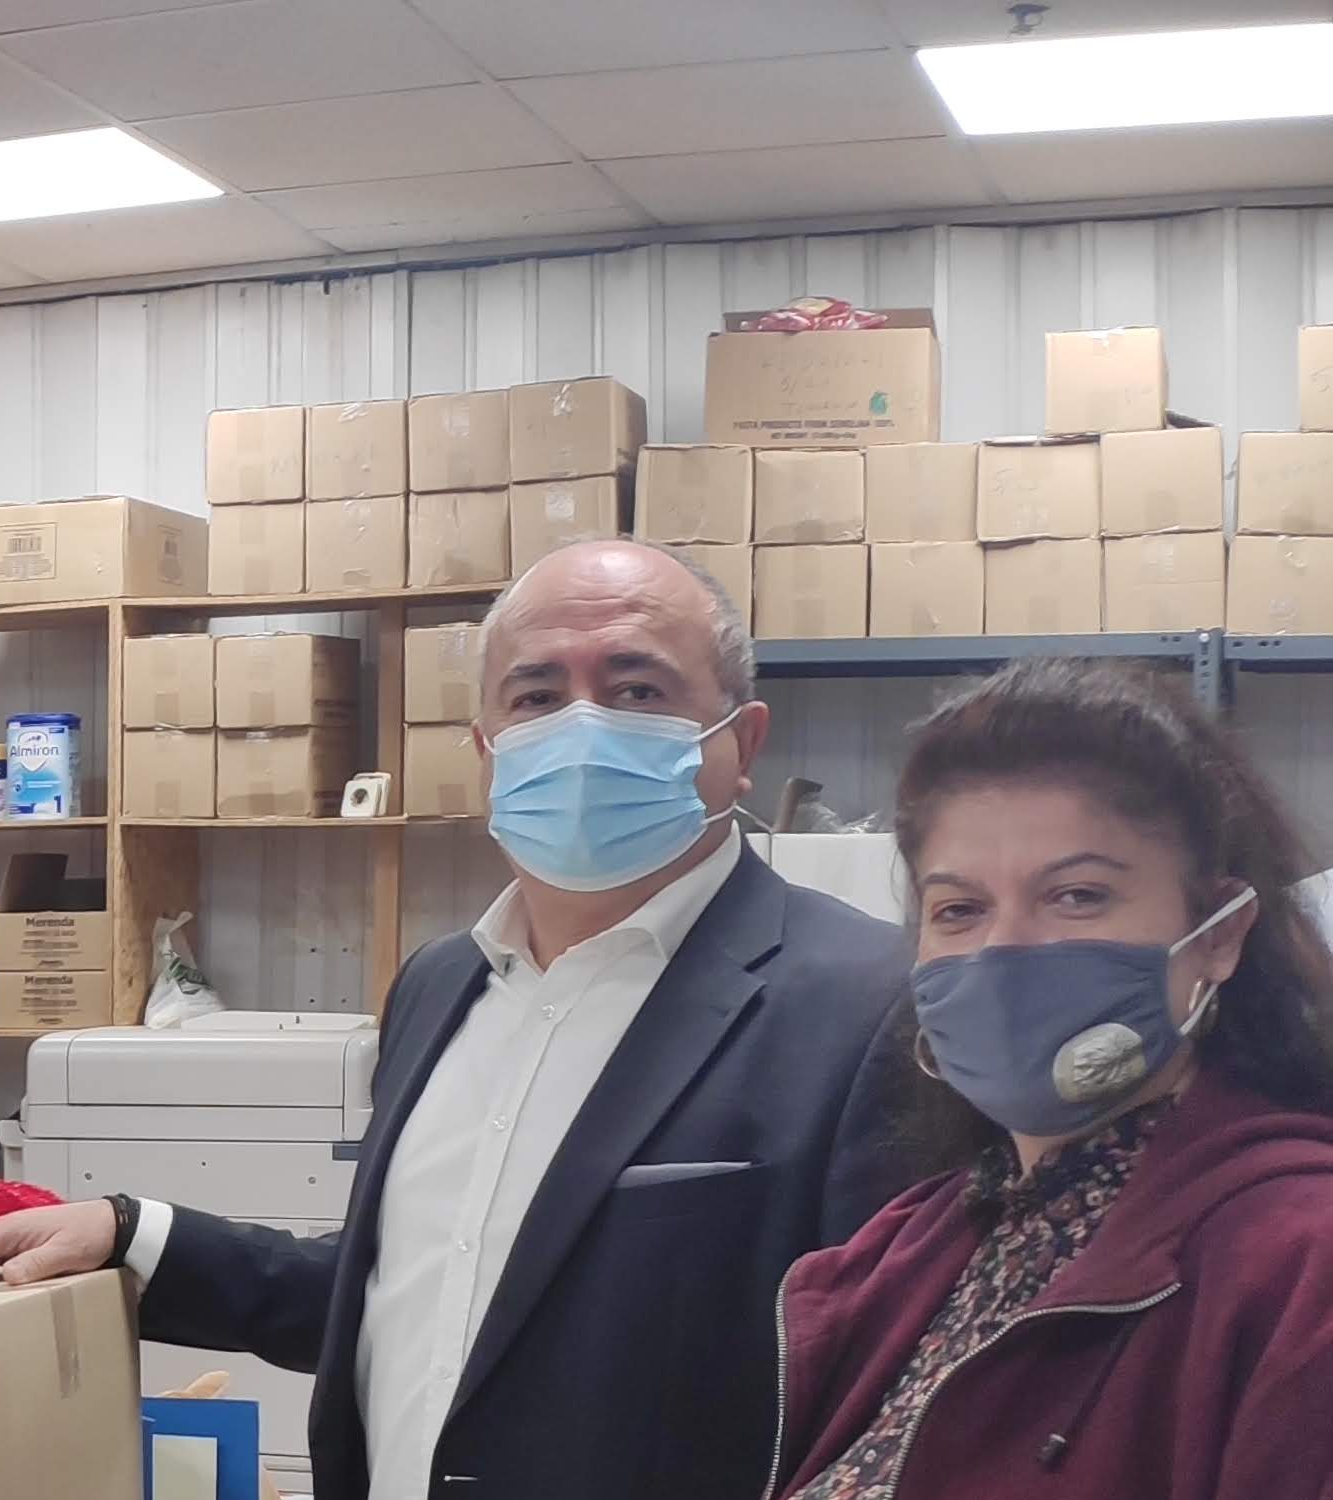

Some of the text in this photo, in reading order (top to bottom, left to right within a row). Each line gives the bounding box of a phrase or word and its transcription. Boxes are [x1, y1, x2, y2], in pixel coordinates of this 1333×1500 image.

[10, 745, 61, 758] Almiron
[25, 917, 75, 928] Merenda
[24, 975, 74, 985] Merenda
